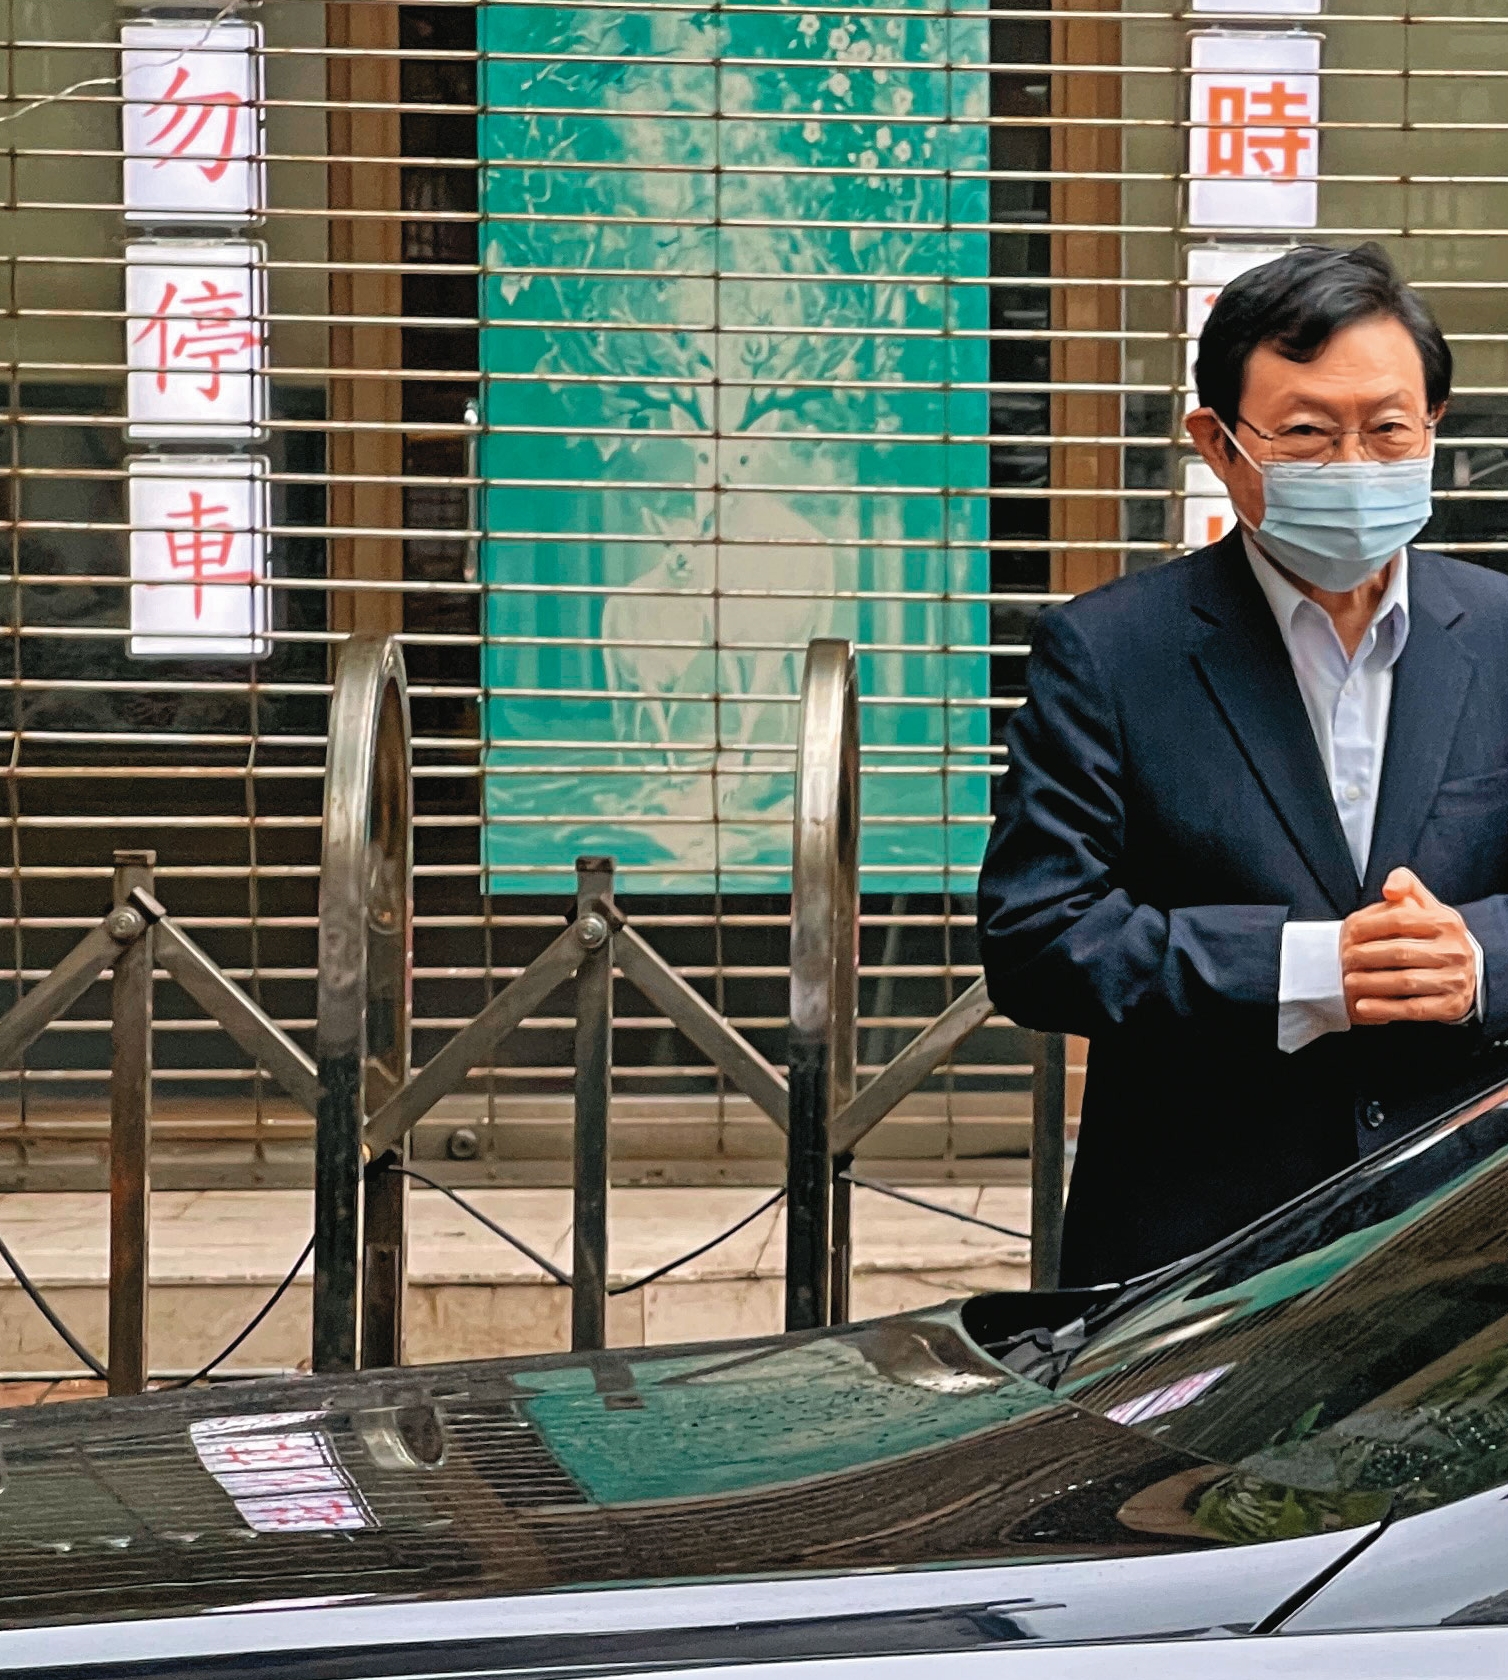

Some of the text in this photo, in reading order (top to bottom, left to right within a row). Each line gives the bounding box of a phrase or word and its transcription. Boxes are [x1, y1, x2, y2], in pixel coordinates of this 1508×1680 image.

[1206, 81, 1310, 184] 時
[133, 66, 262, 620] 勿停車
